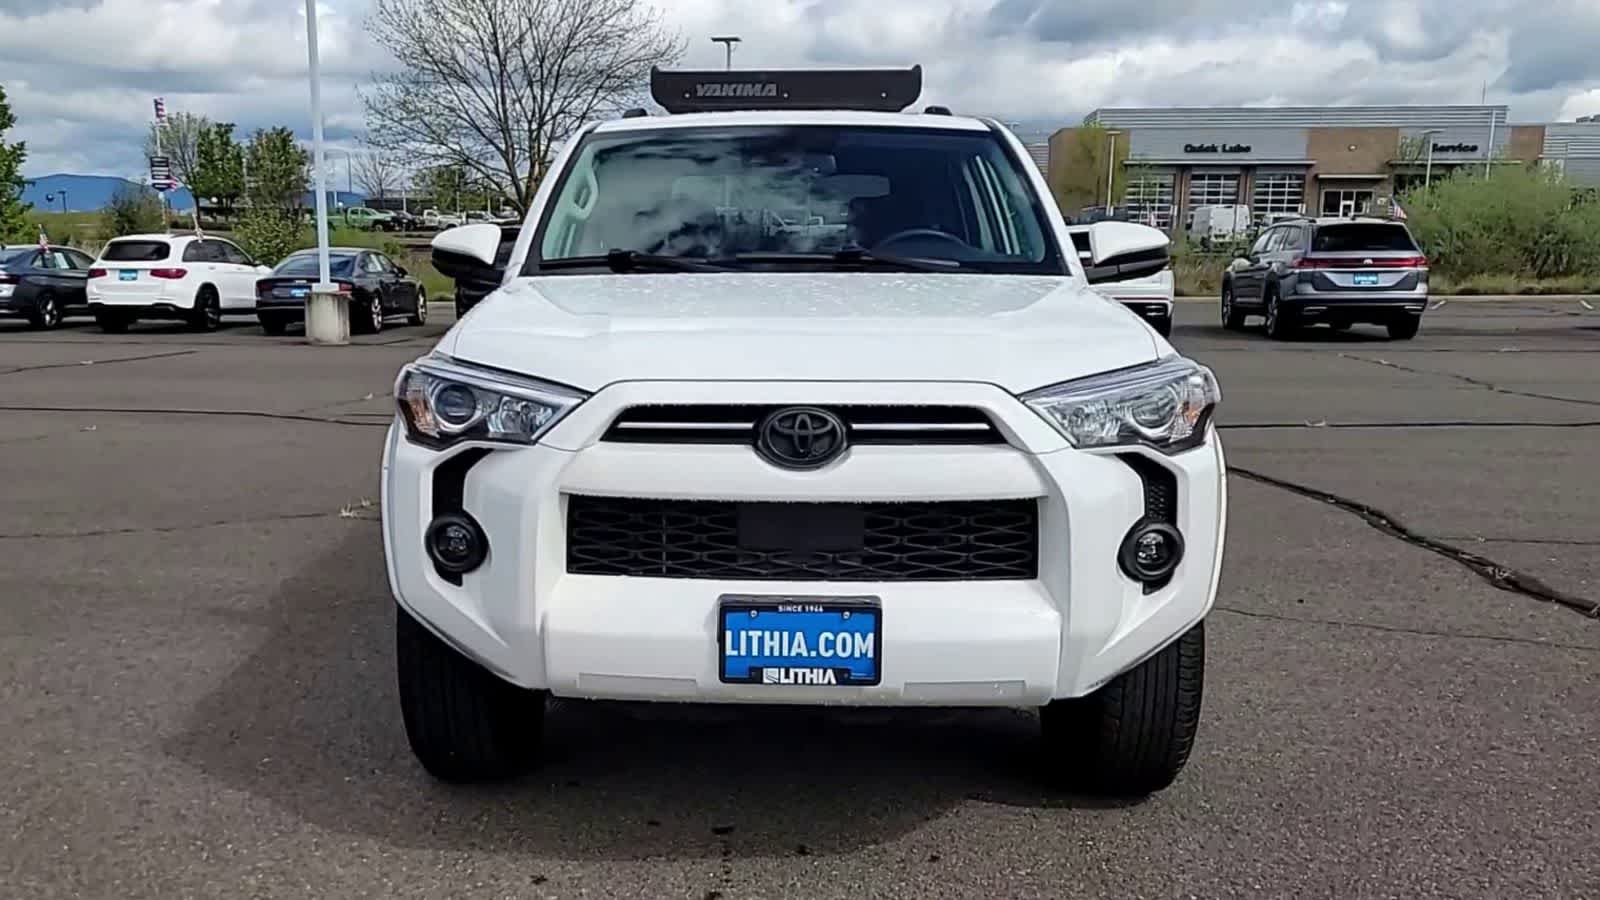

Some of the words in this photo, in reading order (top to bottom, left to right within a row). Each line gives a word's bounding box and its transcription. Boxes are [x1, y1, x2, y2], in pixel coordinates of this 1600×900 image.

[696, 83, 776, 97] YAKIMA
[1184, 143, 1218, 153] Quick
[1222, 143, 1251, 153] Lube
[777, 604, 802, 613] SINCE
[725, 629, 875, 659] LITHIA.COM
[779, 667, 837, 685] LITHIA
